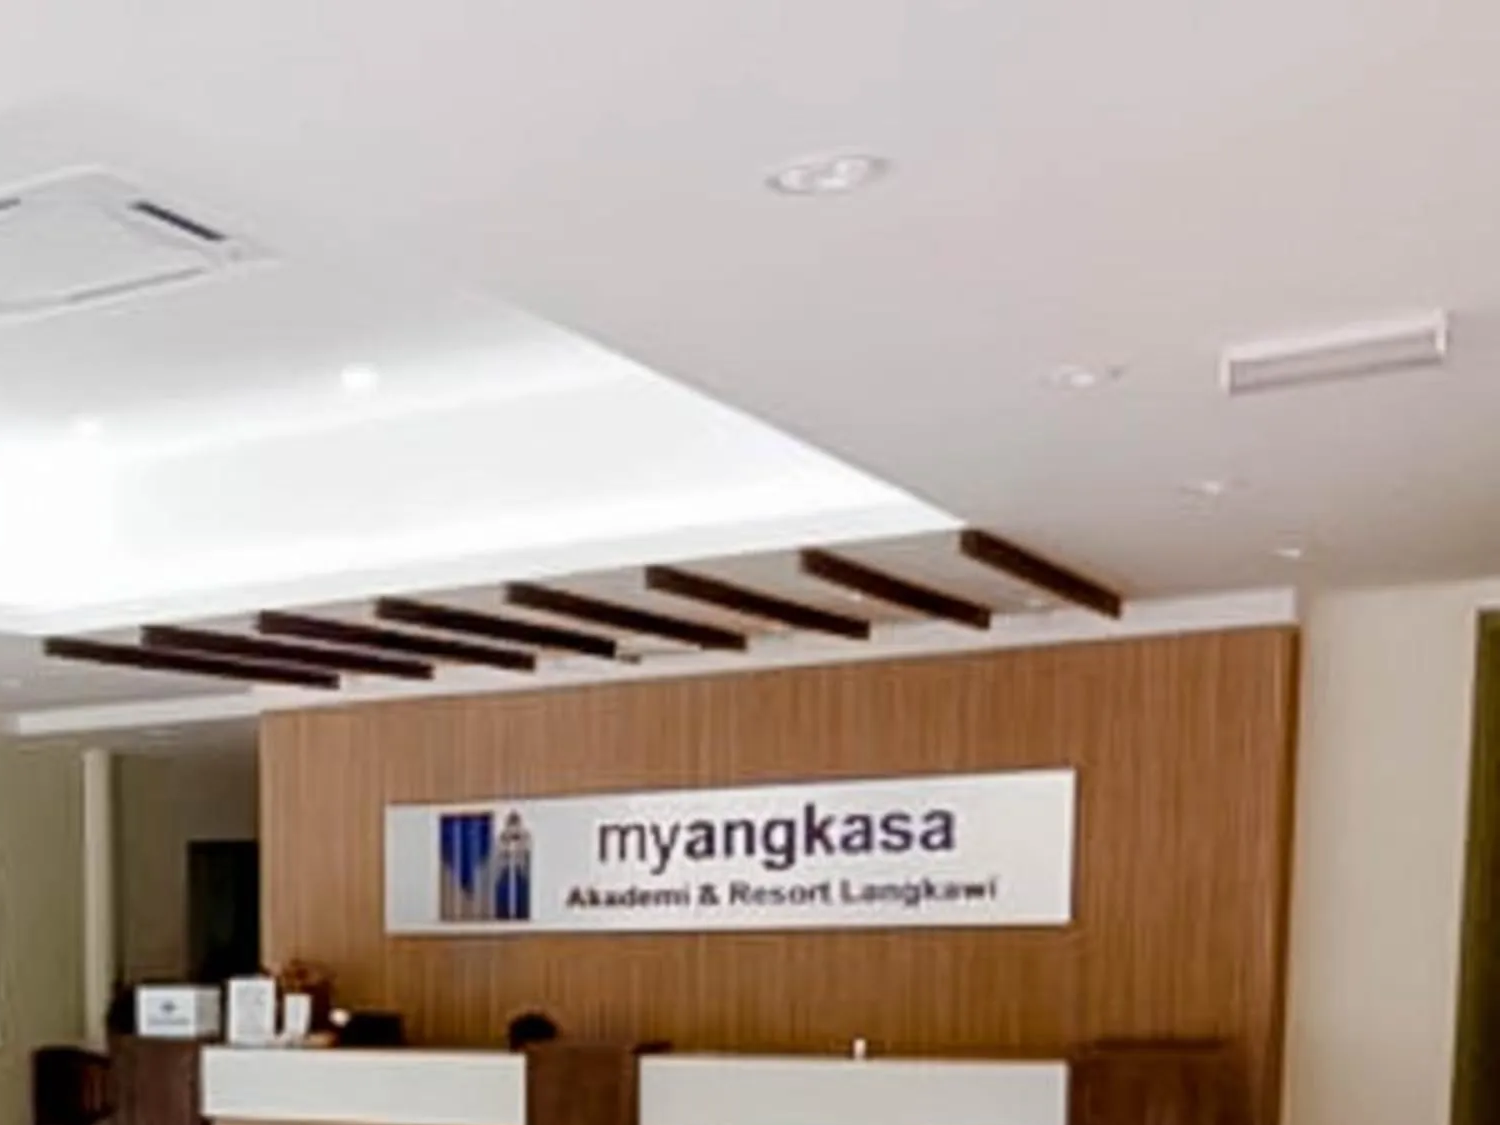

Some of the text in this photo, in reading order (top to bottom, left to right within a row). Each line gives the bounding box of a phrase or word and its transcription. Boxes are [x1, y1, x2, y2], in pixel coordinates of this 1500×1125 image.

[598, 802, 956, 876] myangkasa
[566, 875, 998, 908] Akademi & Resort Langkawi
